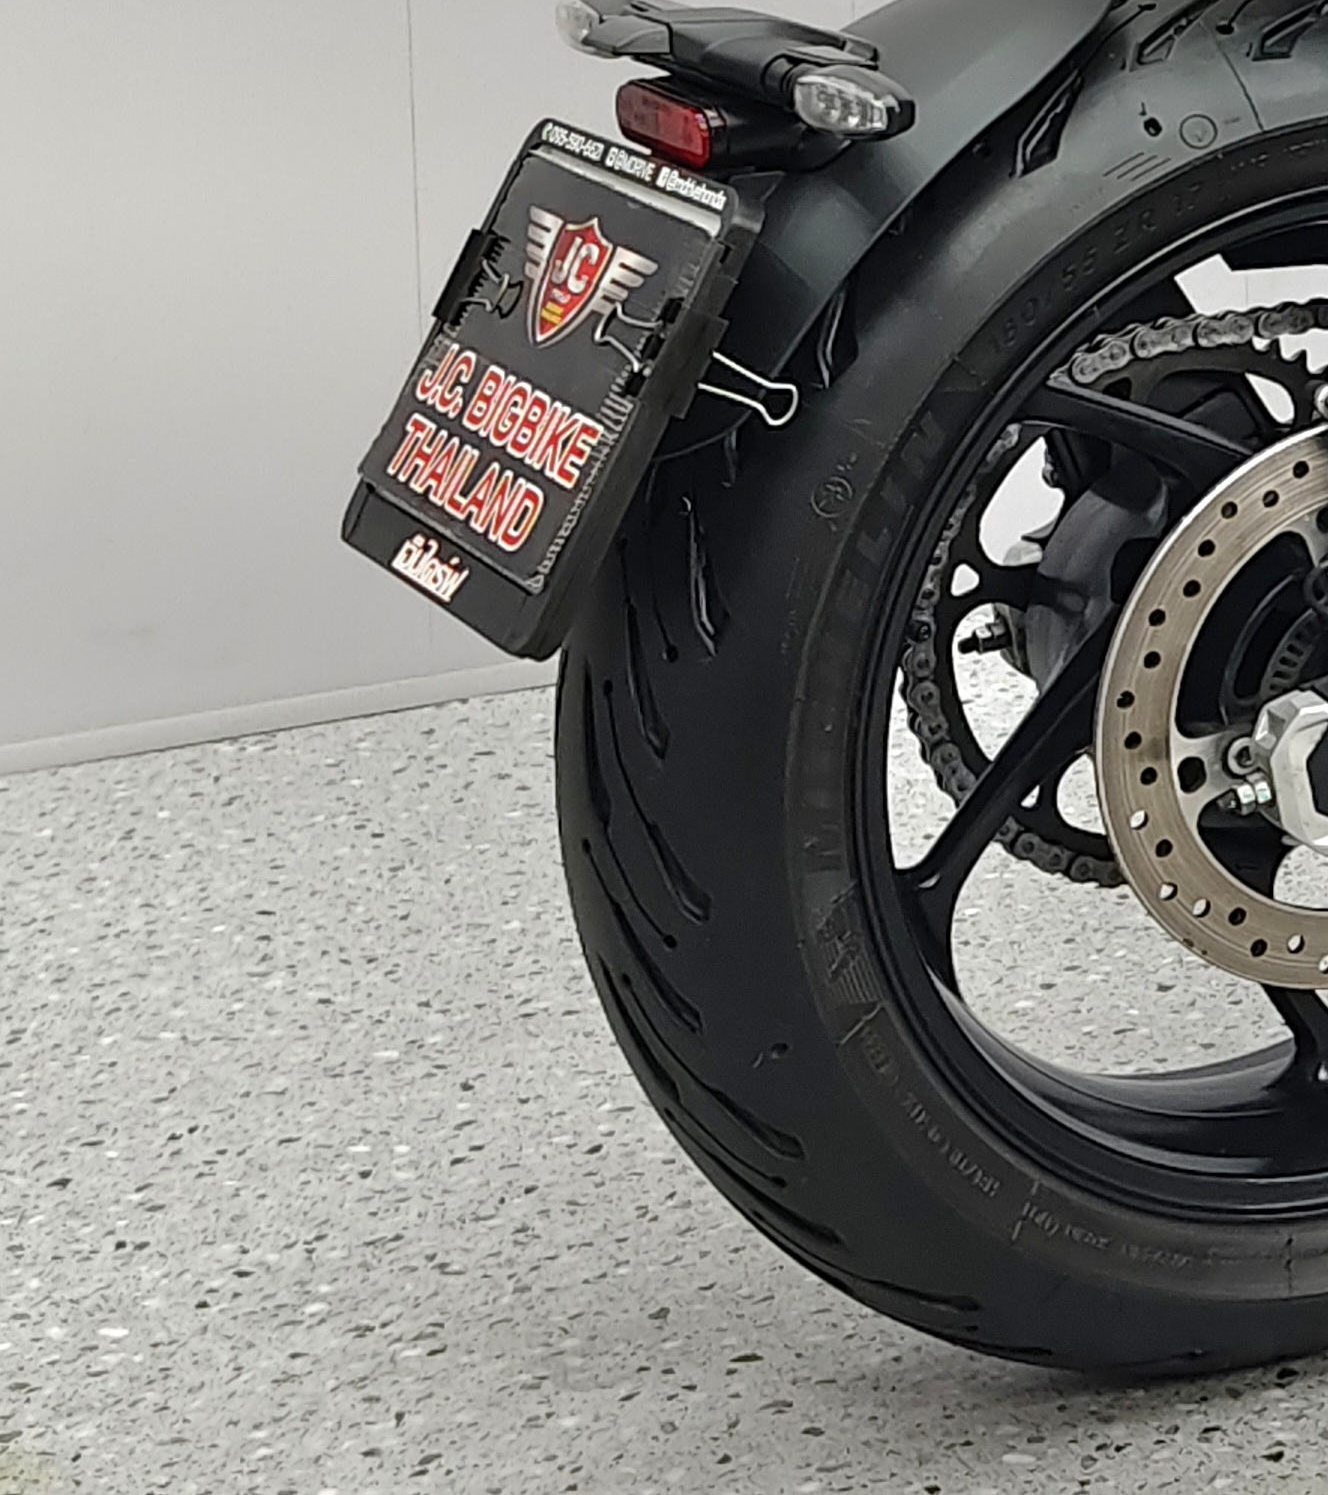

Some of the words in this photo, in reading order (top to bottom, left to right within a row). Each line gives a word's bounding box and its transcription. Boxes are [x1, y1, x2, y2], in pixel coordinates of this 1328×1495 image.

[551, 235, 600, 294] JC
[386, 413, 544, 552] THAILAND
[462, 364, 604, 489] BIGBIKE
